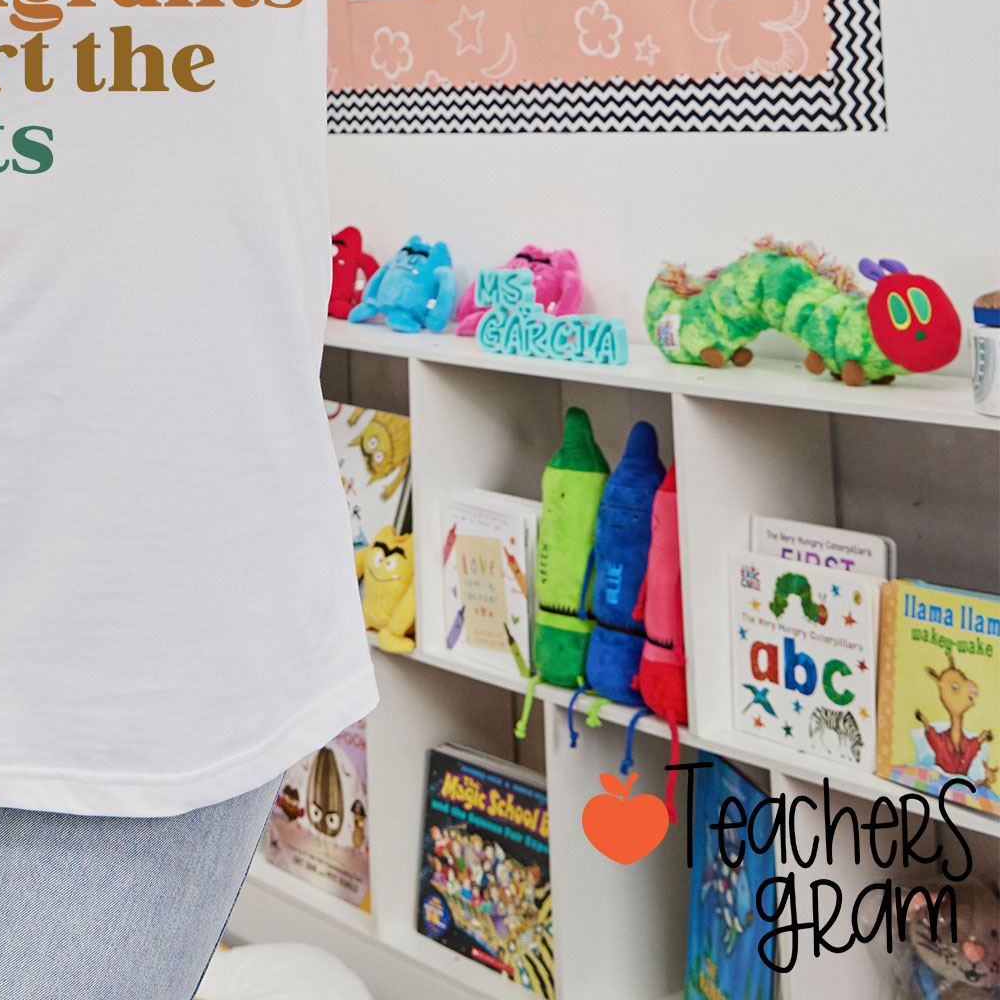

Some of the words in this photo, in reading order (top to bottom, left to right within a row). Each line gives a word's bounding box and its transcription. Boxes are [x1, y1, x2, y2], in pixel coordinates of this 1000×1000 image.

[72, 25, 217, 93] the
[479, 308, 617, 365] GARCIA
[904, 593, 955, 628] llama
[960, 605, 1000, 638] llam
[911, 626, 994, 658] wakey-wake
[750, 636, 856, 706] abc
[440, 770, 487, 811] Magic
[486, 788, 541, 833] School
